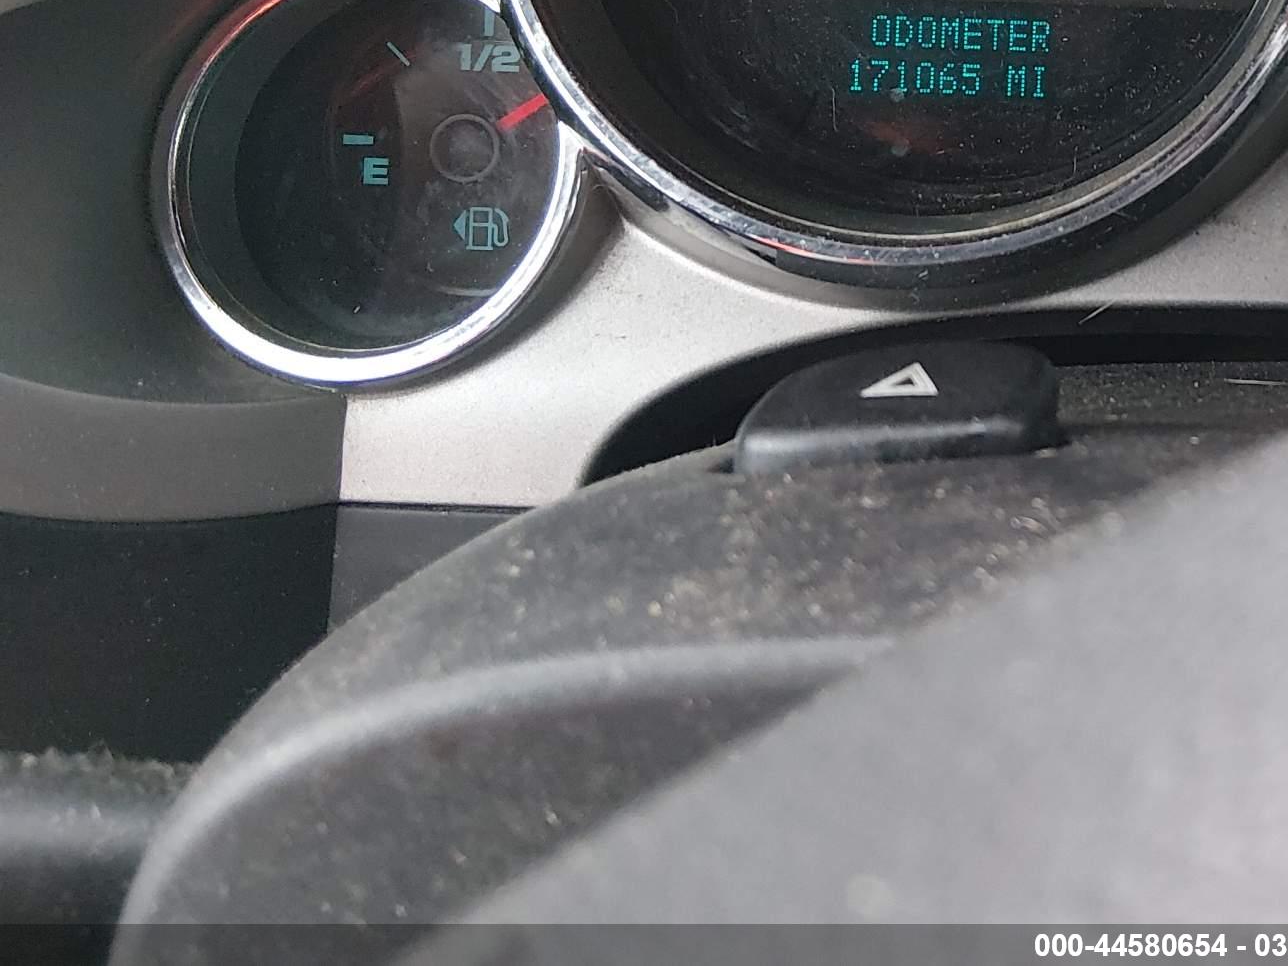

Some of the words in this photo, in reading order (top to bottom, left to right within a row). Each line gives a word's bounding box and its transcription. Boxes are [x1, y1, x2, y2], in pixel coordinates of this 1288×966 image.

[872, 15, 1050, 52] ODOMETER
[459, 43, 521, 73] 1/2
[850, 60, 981, 95] 171065
[1006, 65, 1045, 98] MI
[363, 157, 389, 185] E
